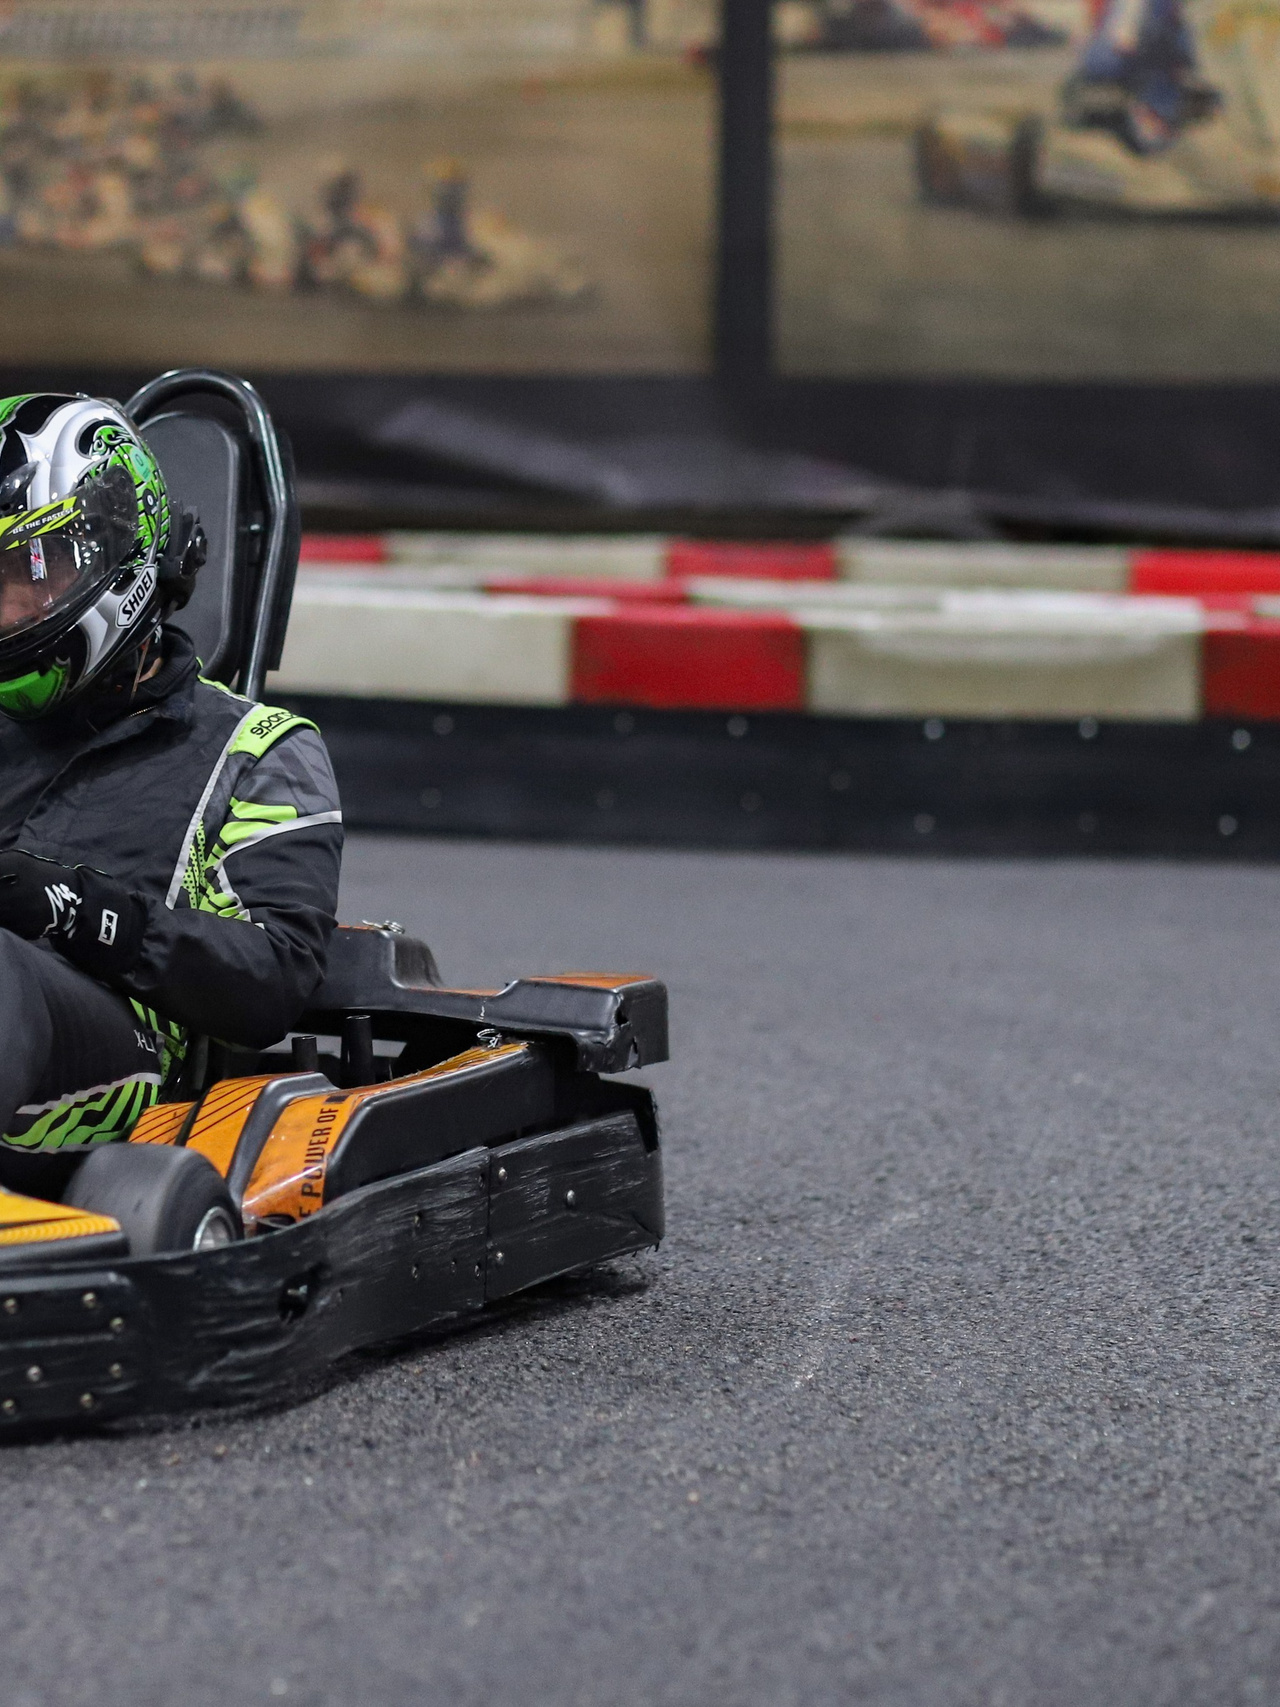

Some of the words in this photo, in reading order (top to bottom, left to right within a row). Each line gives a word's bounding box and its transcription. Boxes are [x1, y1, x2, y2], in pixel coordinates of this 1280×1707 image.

[25, 521, 40, 530] THE
[41, 507, 74, 524] FASTEST
[122, 571, 153, 622] SHOEI
[316, 1107, 340, 1123] OF
[300, 1126, 333, 1198] POWER
